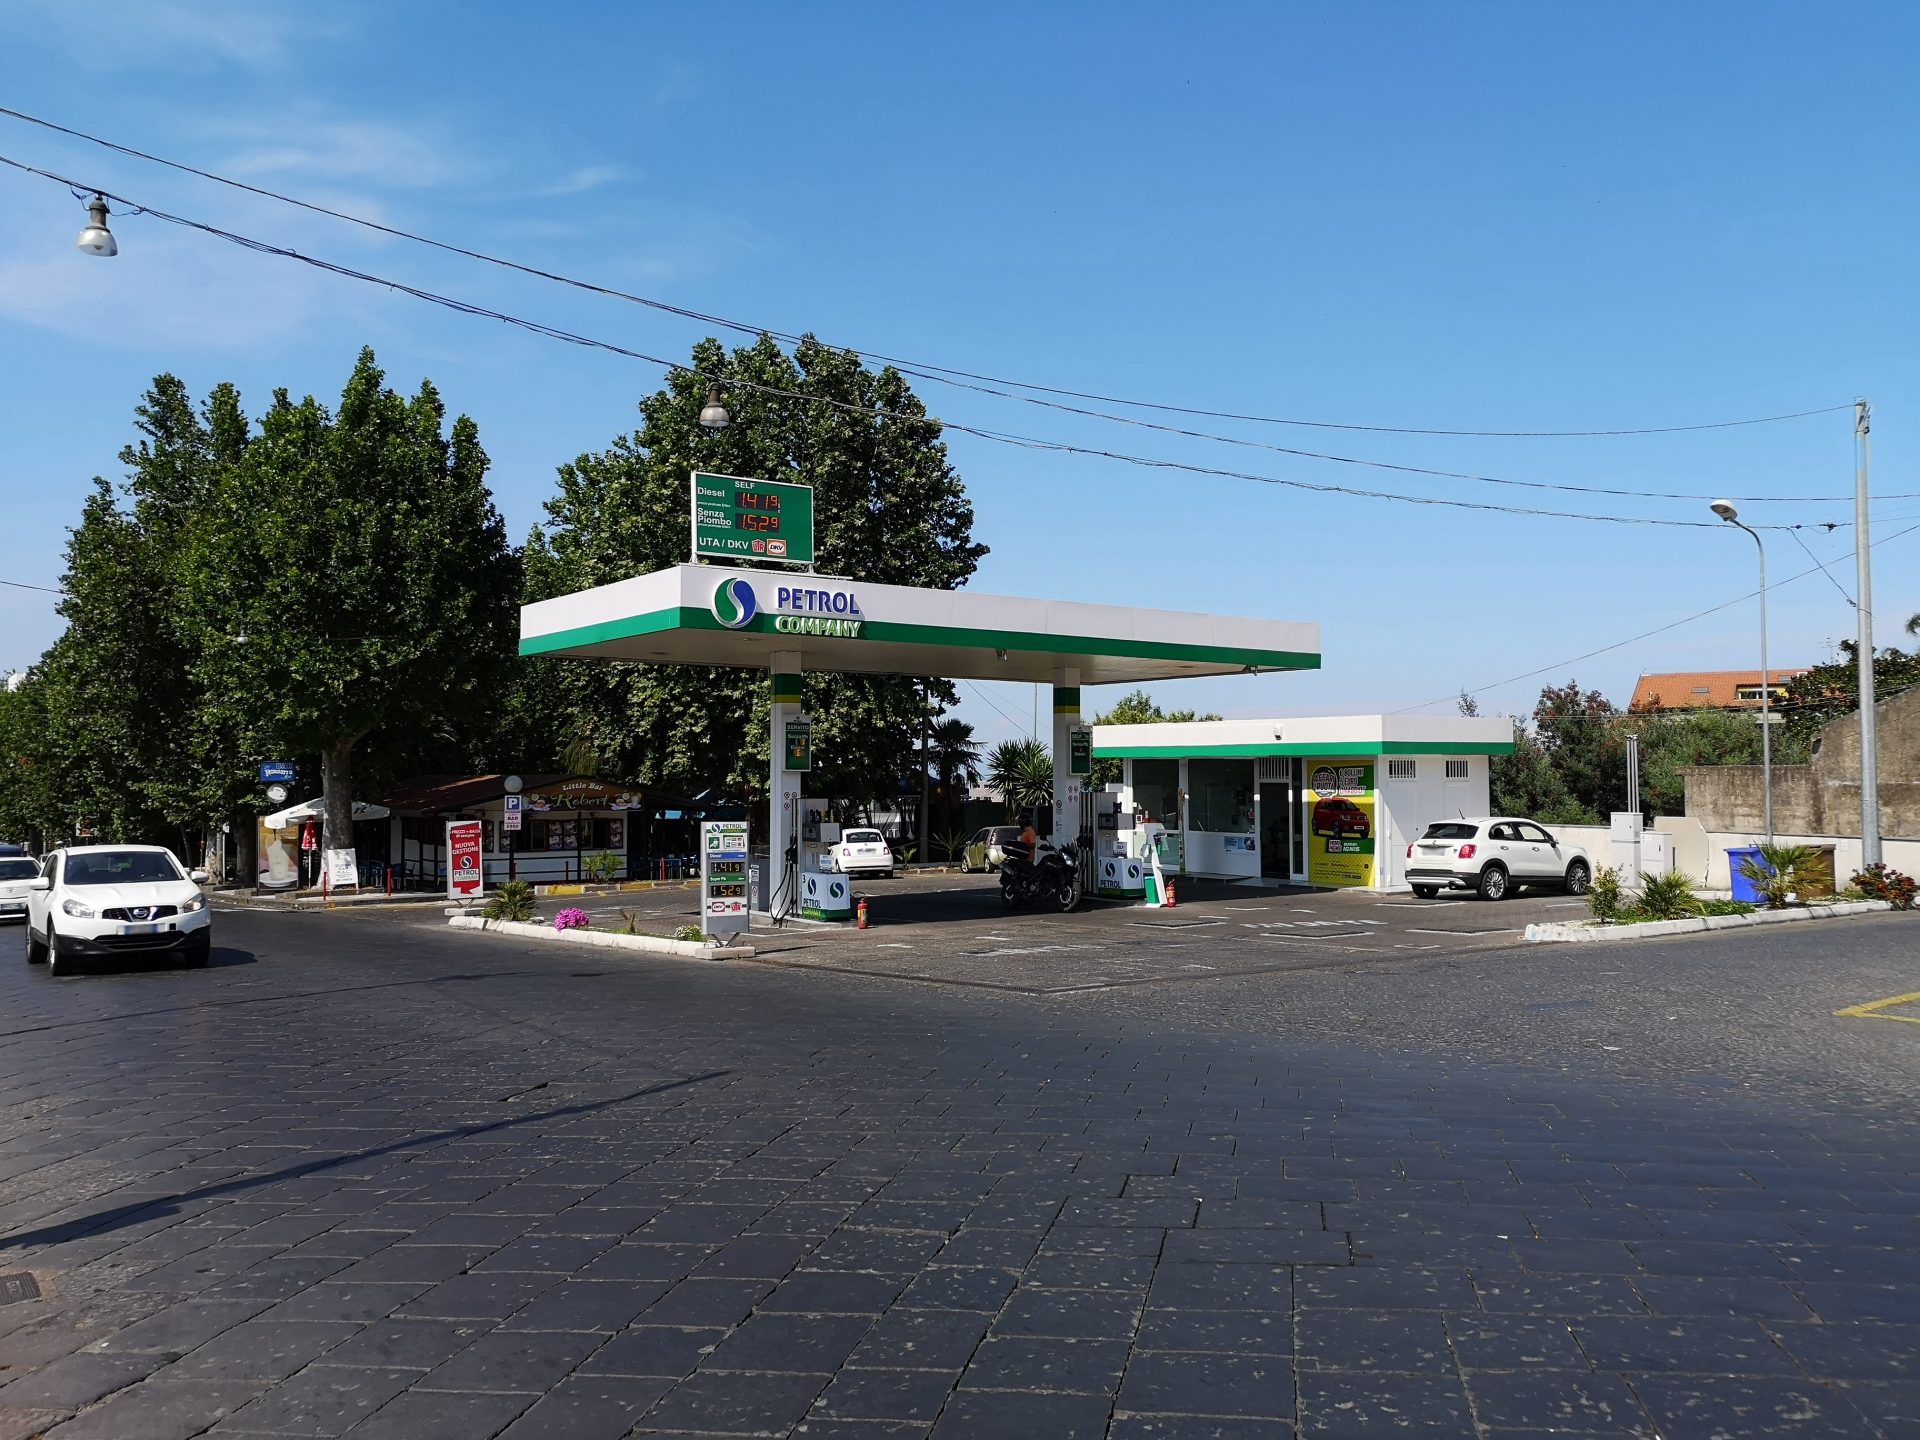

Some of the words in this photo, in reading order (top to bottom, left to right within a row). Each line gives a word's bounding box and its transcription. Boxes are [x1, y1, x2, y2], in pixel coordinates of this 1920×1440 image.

[734, 481, 756, 490] SELF
[697, 487, 725, 497] Diesel
[697, 508, 724, 518] Senza
[698, 515, 732, 525] Piombo
[742, 514, 778, 532] 1.529
[700, 537, 720, 547] UTA
[728, 540, 749, 549] DKV
[778, 587, 860, 614] PETROL
[776, 616, 862, 638] COMPANY
[588, 782, 604, 790] Bar
[509, 798, 518, 808] P
[452, 846, 479, 854] GESTIONE
[802, 875, 806, 883] 3
[1100, 880, 1121, 888] PETROL
[803, 898, 821, 908] PETROL
